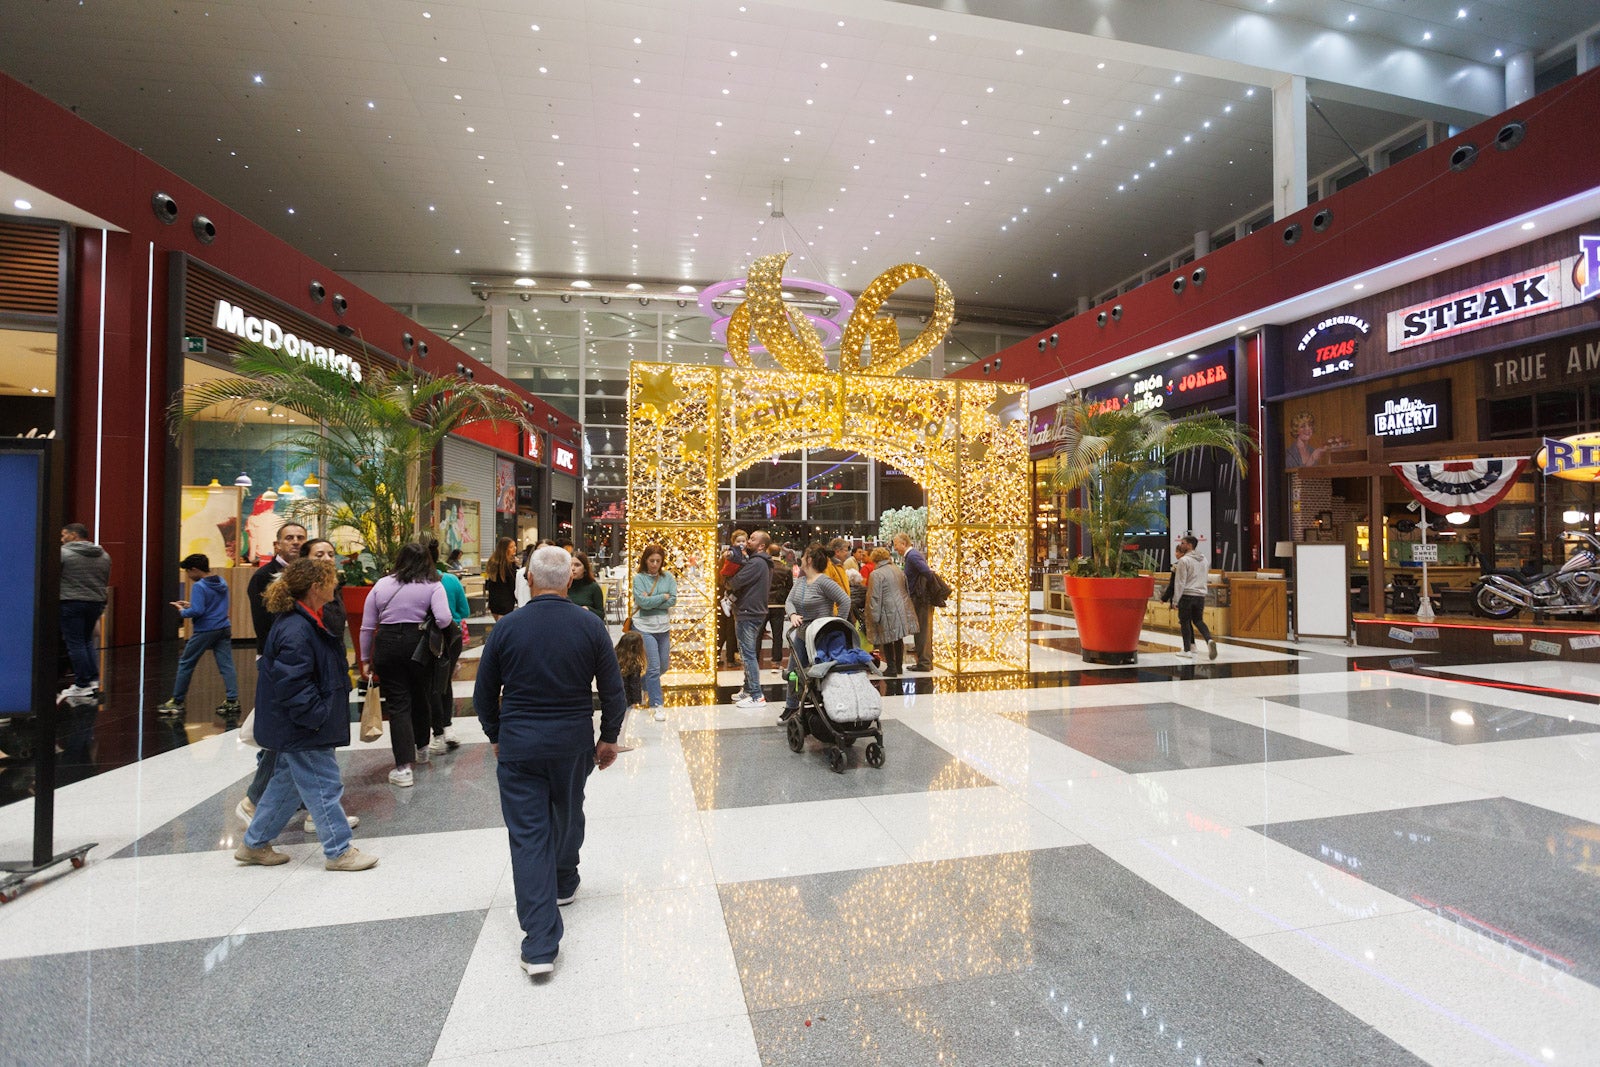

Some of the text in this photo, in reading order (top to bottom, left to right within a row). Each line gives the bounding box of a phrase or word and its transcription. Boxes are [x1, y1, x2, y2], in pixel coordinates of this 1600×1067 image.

[1404, 275, 1548, 338] STEAK
[212, 300, 362, 383] McDonald's
[1298, 315, 1369, 351] THE ORIGINAL
[1316, 339, 1355, 363] TEXAS
[1178, 365, 1227, 392] JOKER
[1312, 360, 1354, 378] B.B.Q.
[1494, 352, 1547, 387] TRUE
[736, 392, 804, 434] Feliz
[1378, 408, 1432, 432] BAKERY
[556, 447, 574, 470] KFC
[1543, 436, 1600, 475] RI
